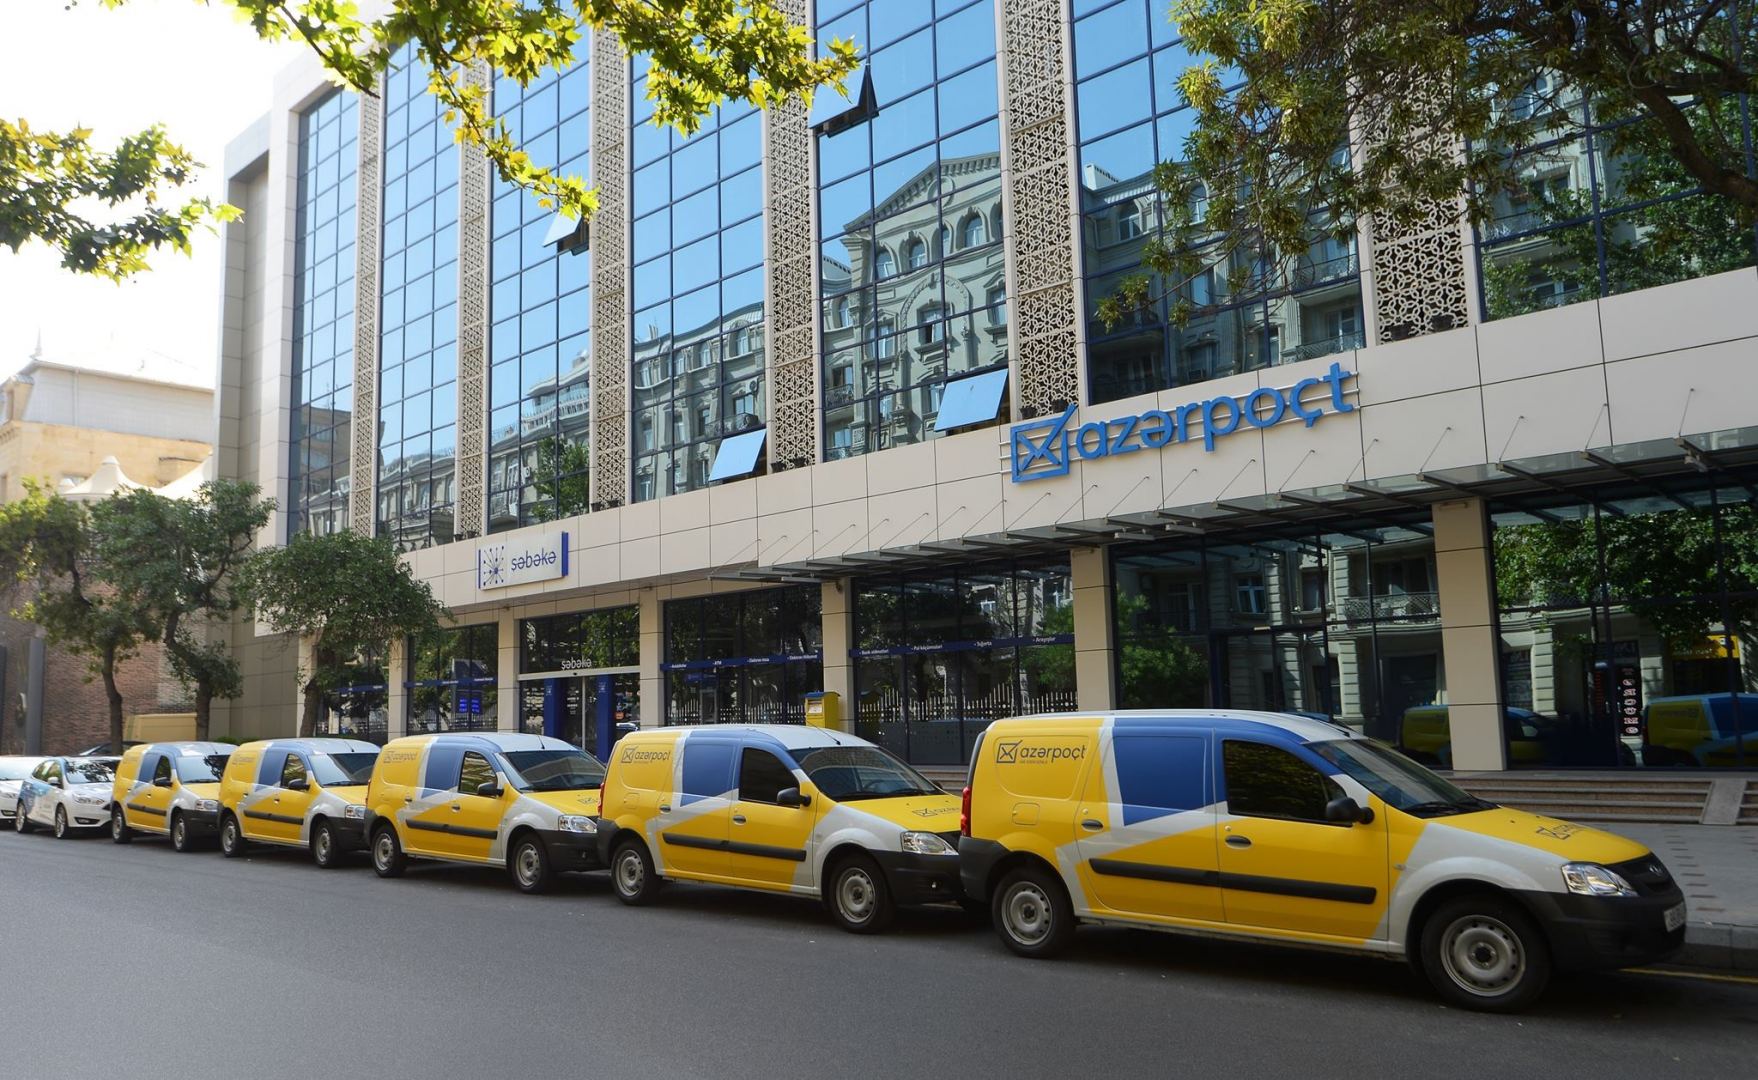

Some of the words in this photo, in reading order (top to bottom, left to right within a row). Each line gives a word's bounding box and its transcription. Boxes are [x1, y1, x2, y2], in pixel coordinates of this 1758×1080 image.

[1075, 362, 1354, 459] azərpoçt
[511, 547, 557, 572] şəbəkə
[1020, 745, 1087, 763] azərpoçt
